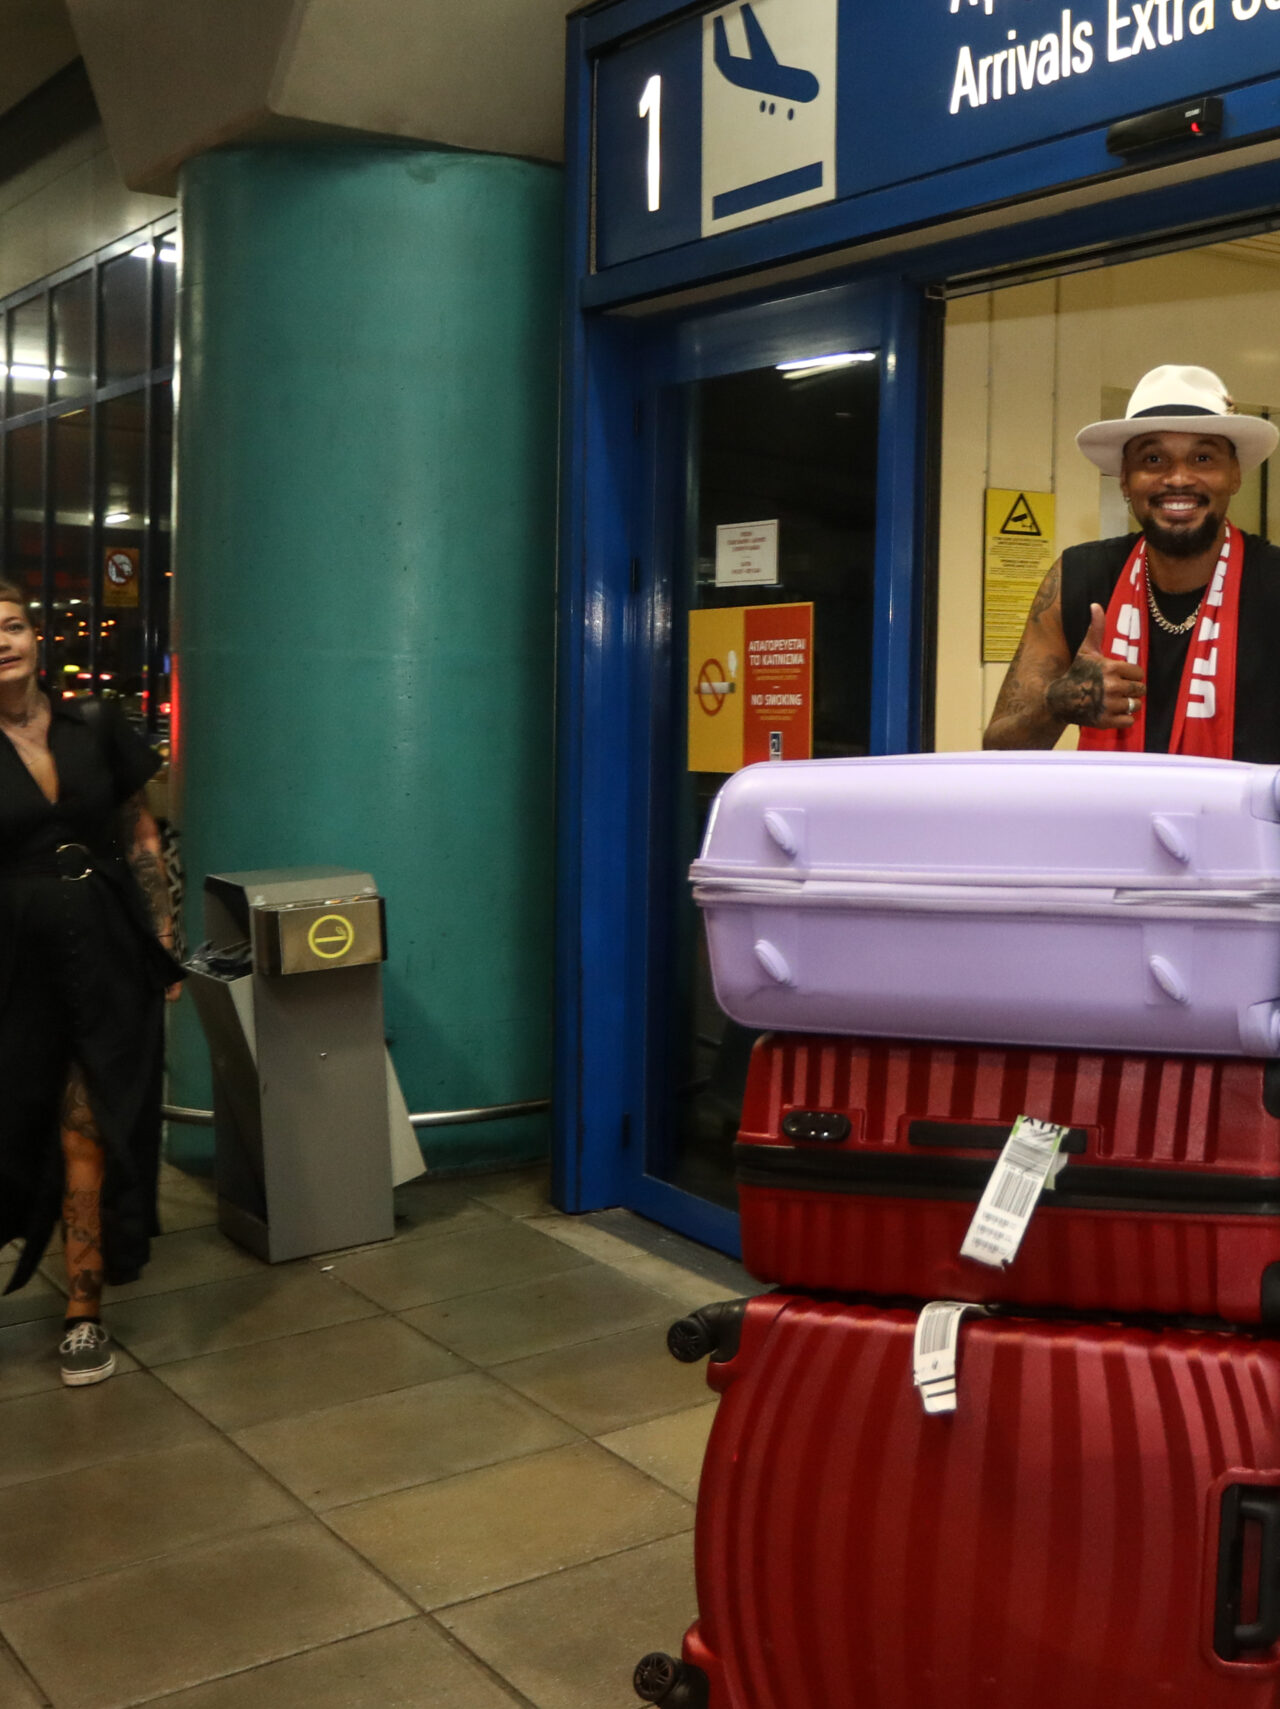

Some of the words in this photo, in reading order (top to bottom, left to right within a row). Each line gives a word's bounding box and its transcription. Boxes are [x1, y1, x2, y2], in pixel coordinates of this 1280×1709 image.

[949, 9, 1093, 114] Arrivals
[1107, 0, 1215, 62] Extra
[637, 74, 662, 213] 1
[748, 638, 806, 651] ΑΠΑΓΟΡΕΥΕΤΑΙ
[749, 654, 760, 666] ΤΟ
[751, 694, 762, 706] NO
[765, 693, 803, 706] SMOKING
